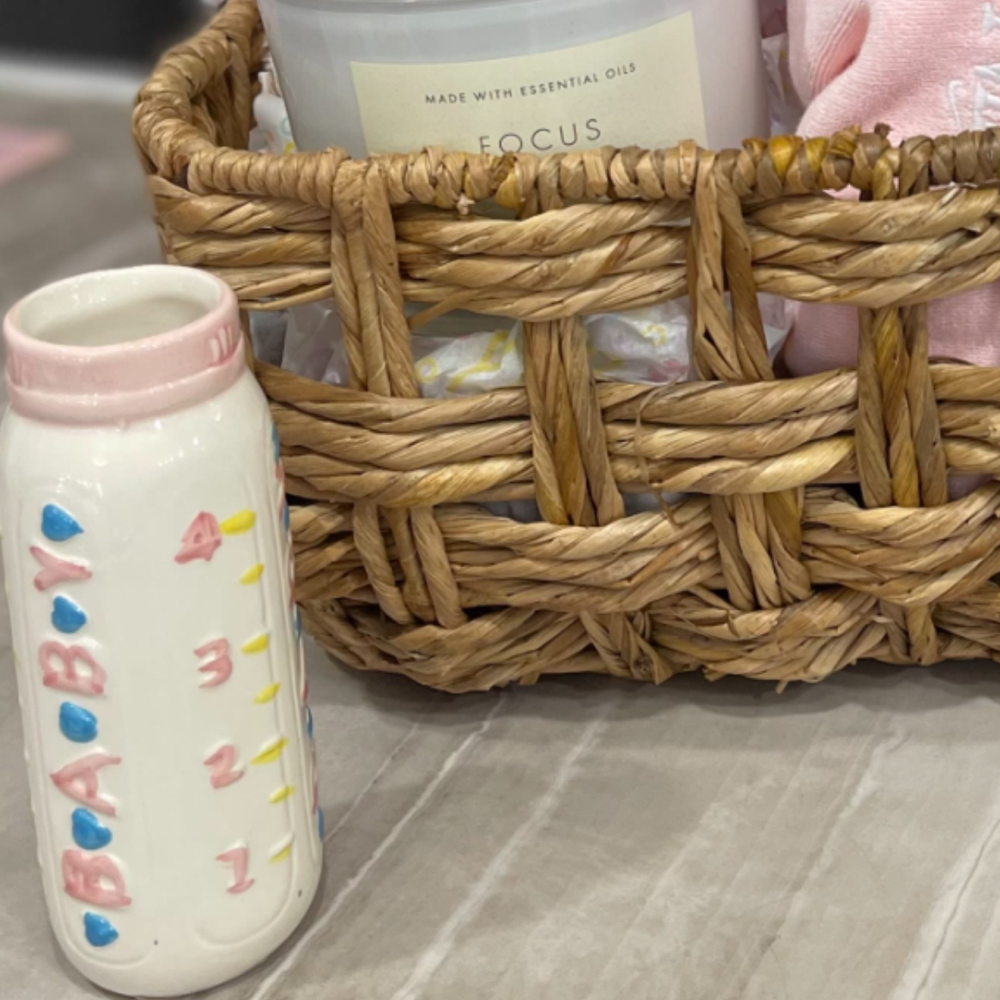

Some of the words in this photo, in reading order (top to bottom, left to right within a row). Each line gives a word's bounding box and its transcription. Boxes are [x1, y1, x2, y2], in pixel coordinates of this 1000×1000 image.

[424, 92, 466, 105] MADE
[473, 88, 513, 102] WITH
[519, 73, 600, 97] ESSENTIAL
[604, 62, 637, 80] OILS
[479, 118, 602, 154] FOCUS
[193, 636, 234, 688] 3
[28, 545, 133, 910] BABY
[203, 742, 246, 789] 2
[215, 846, 256, 895] 1
